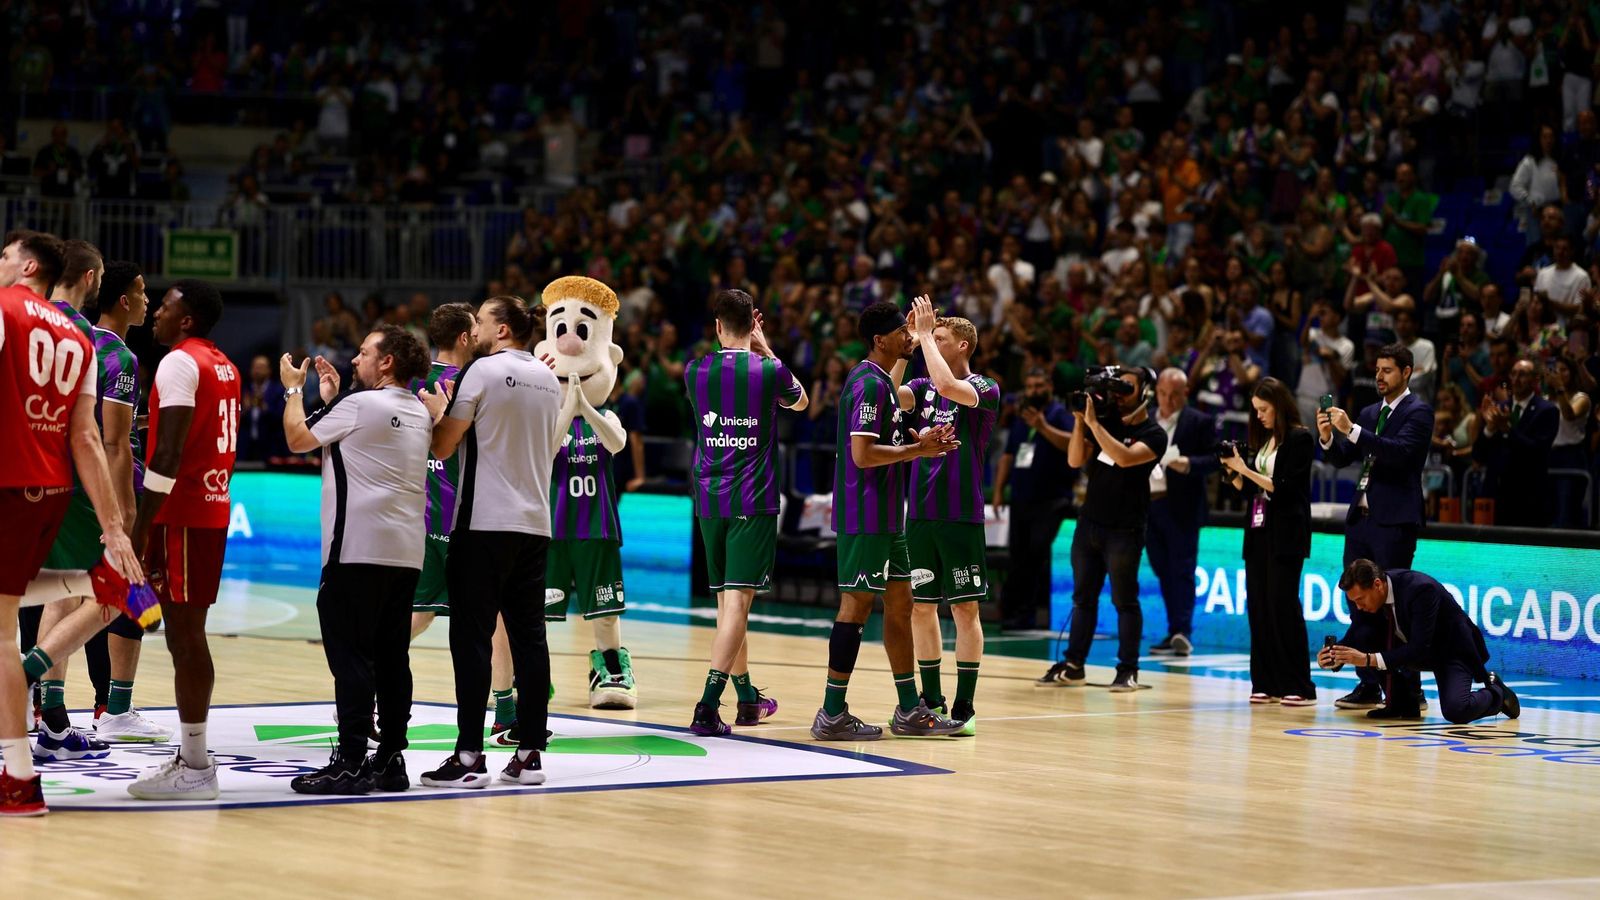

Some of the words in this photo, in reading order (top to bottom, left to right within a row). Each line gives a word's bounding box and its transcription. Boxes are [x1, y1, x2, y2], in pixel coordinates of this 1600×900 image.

[29, 327, 84, 397] 00
[719, 416, 758, 428] Unicaja
[706, 432, 757, 450] málaga
[569, 475, 597, 498] 00
[1440, 583, 1600, 645] ICADO
